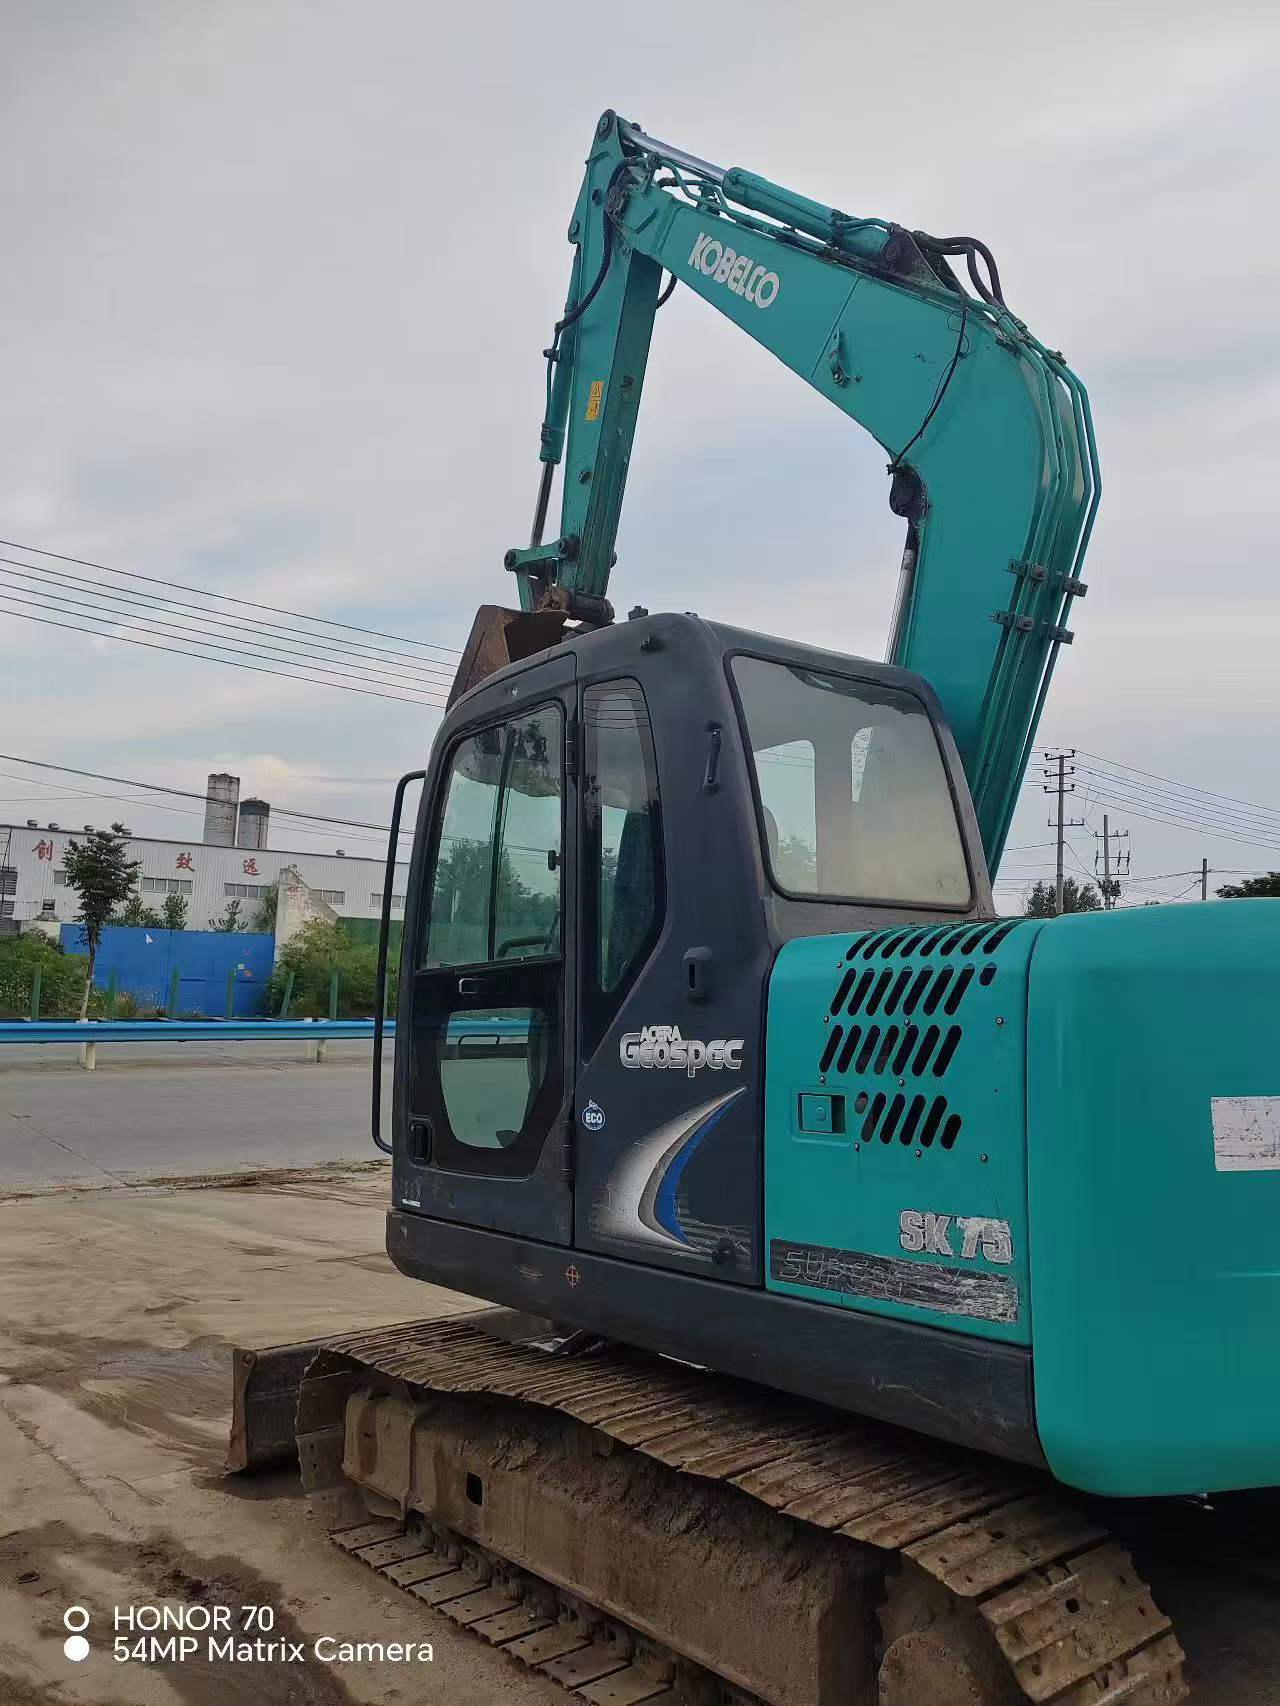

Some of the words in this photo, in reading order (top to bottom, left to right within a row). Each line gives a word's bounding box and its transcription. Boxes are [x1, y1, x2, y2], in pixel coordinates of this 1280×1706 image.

[688, 232, 780, 309] KOBELCO
[640, 1026, 682, 1042] ACERA
[585, 1112, 603, 1124] ECO
